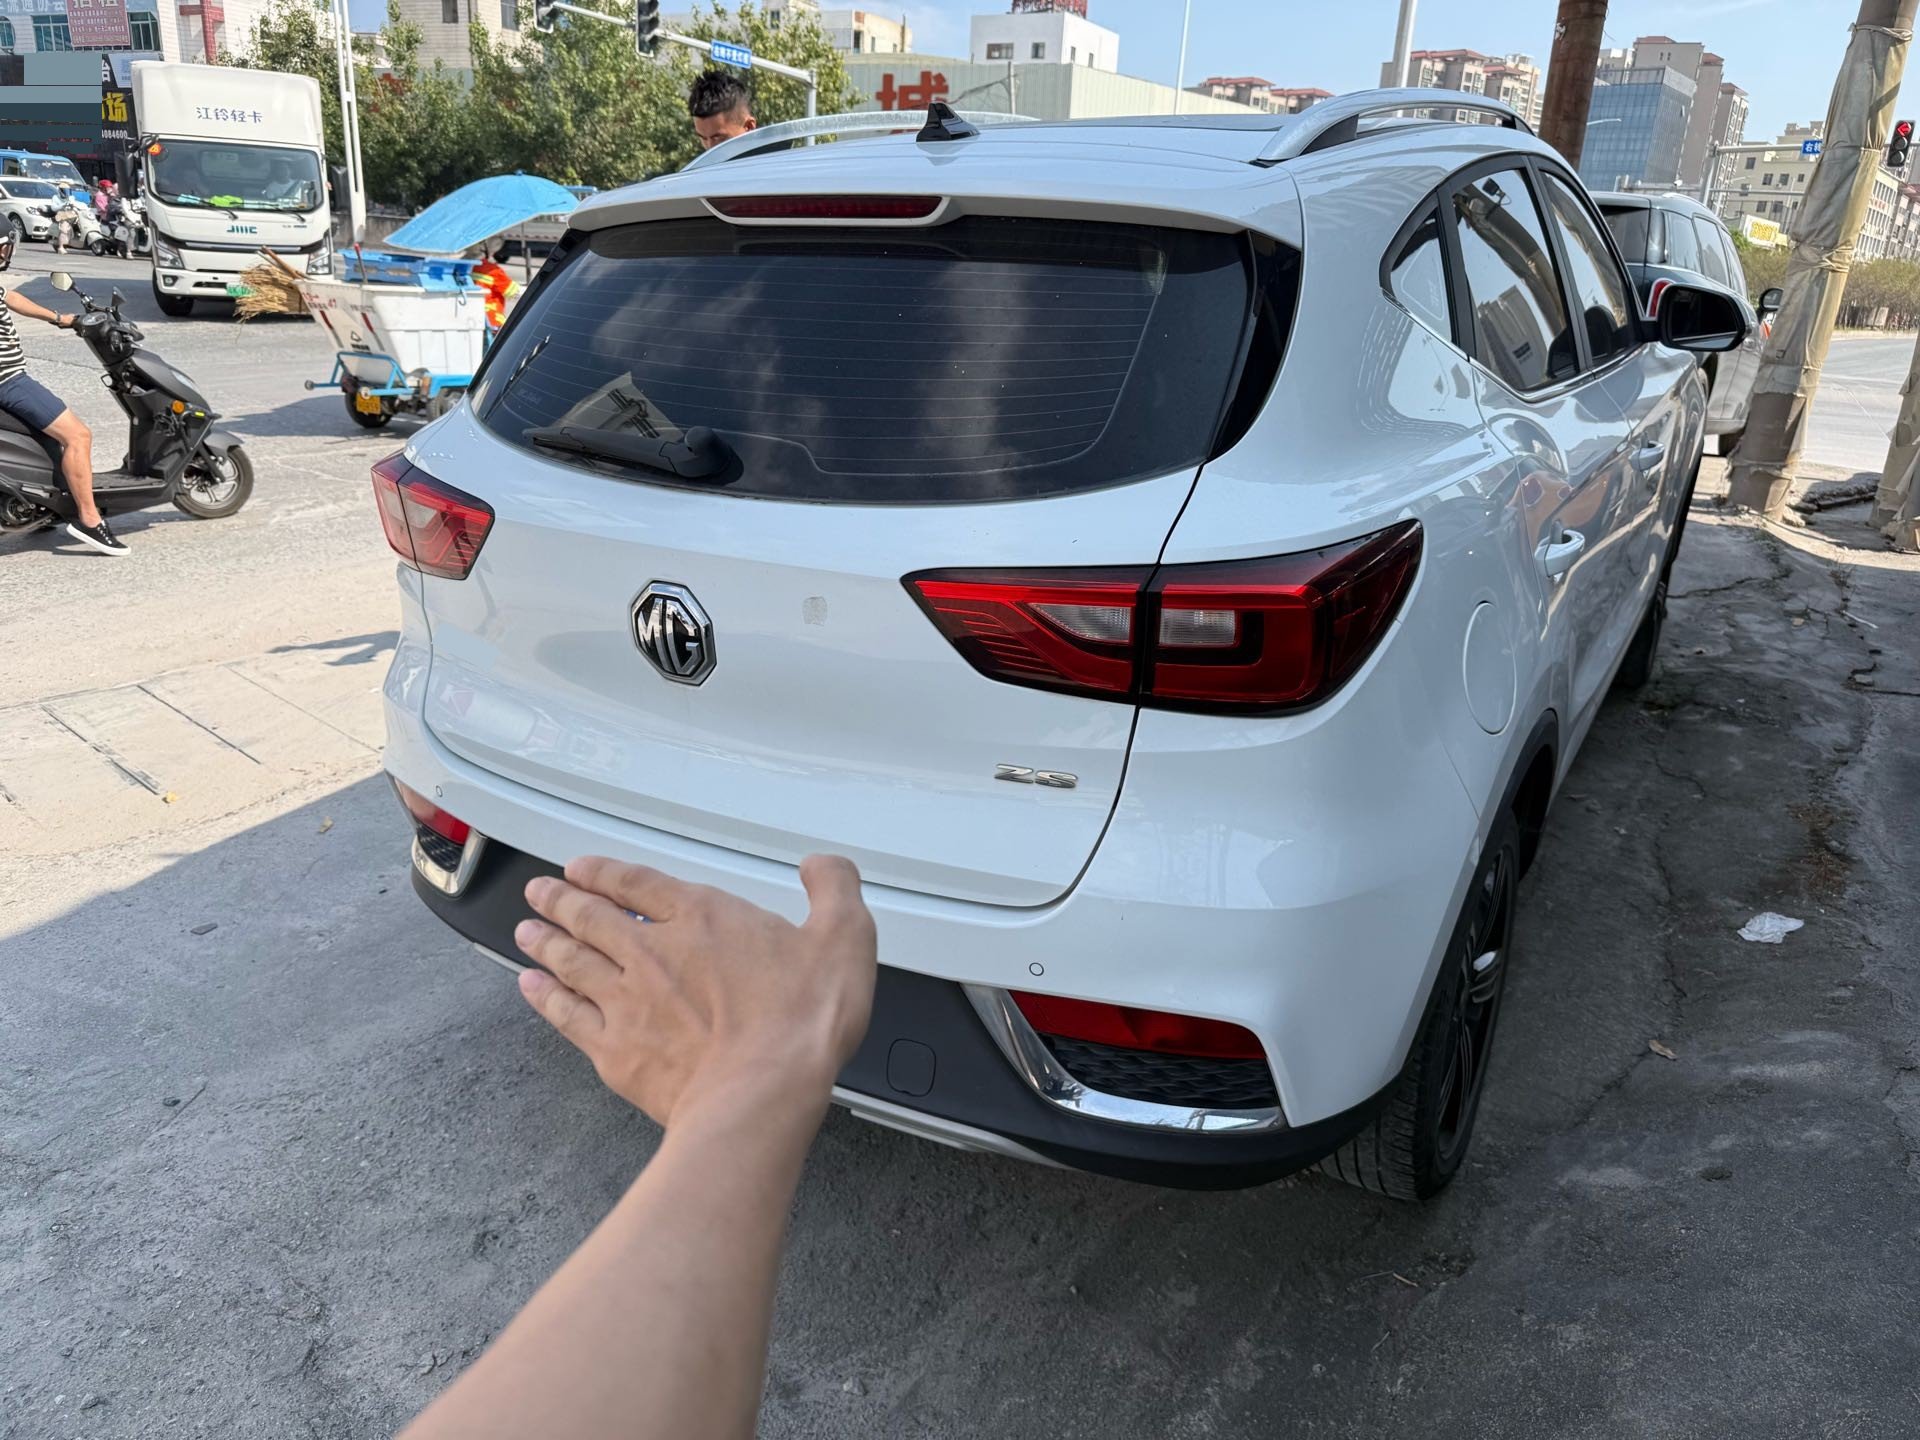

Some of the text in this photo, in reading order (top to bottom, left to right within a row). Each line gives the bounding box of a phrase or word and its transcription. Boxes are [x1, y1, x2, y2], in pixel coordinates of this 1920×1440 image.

[102, 91, 128, 123] 场
[195, 106, 263, 124] 江铃轻卡
[637, 597, 700, 676] MG
[993, 763, 1079, 789] ZS
